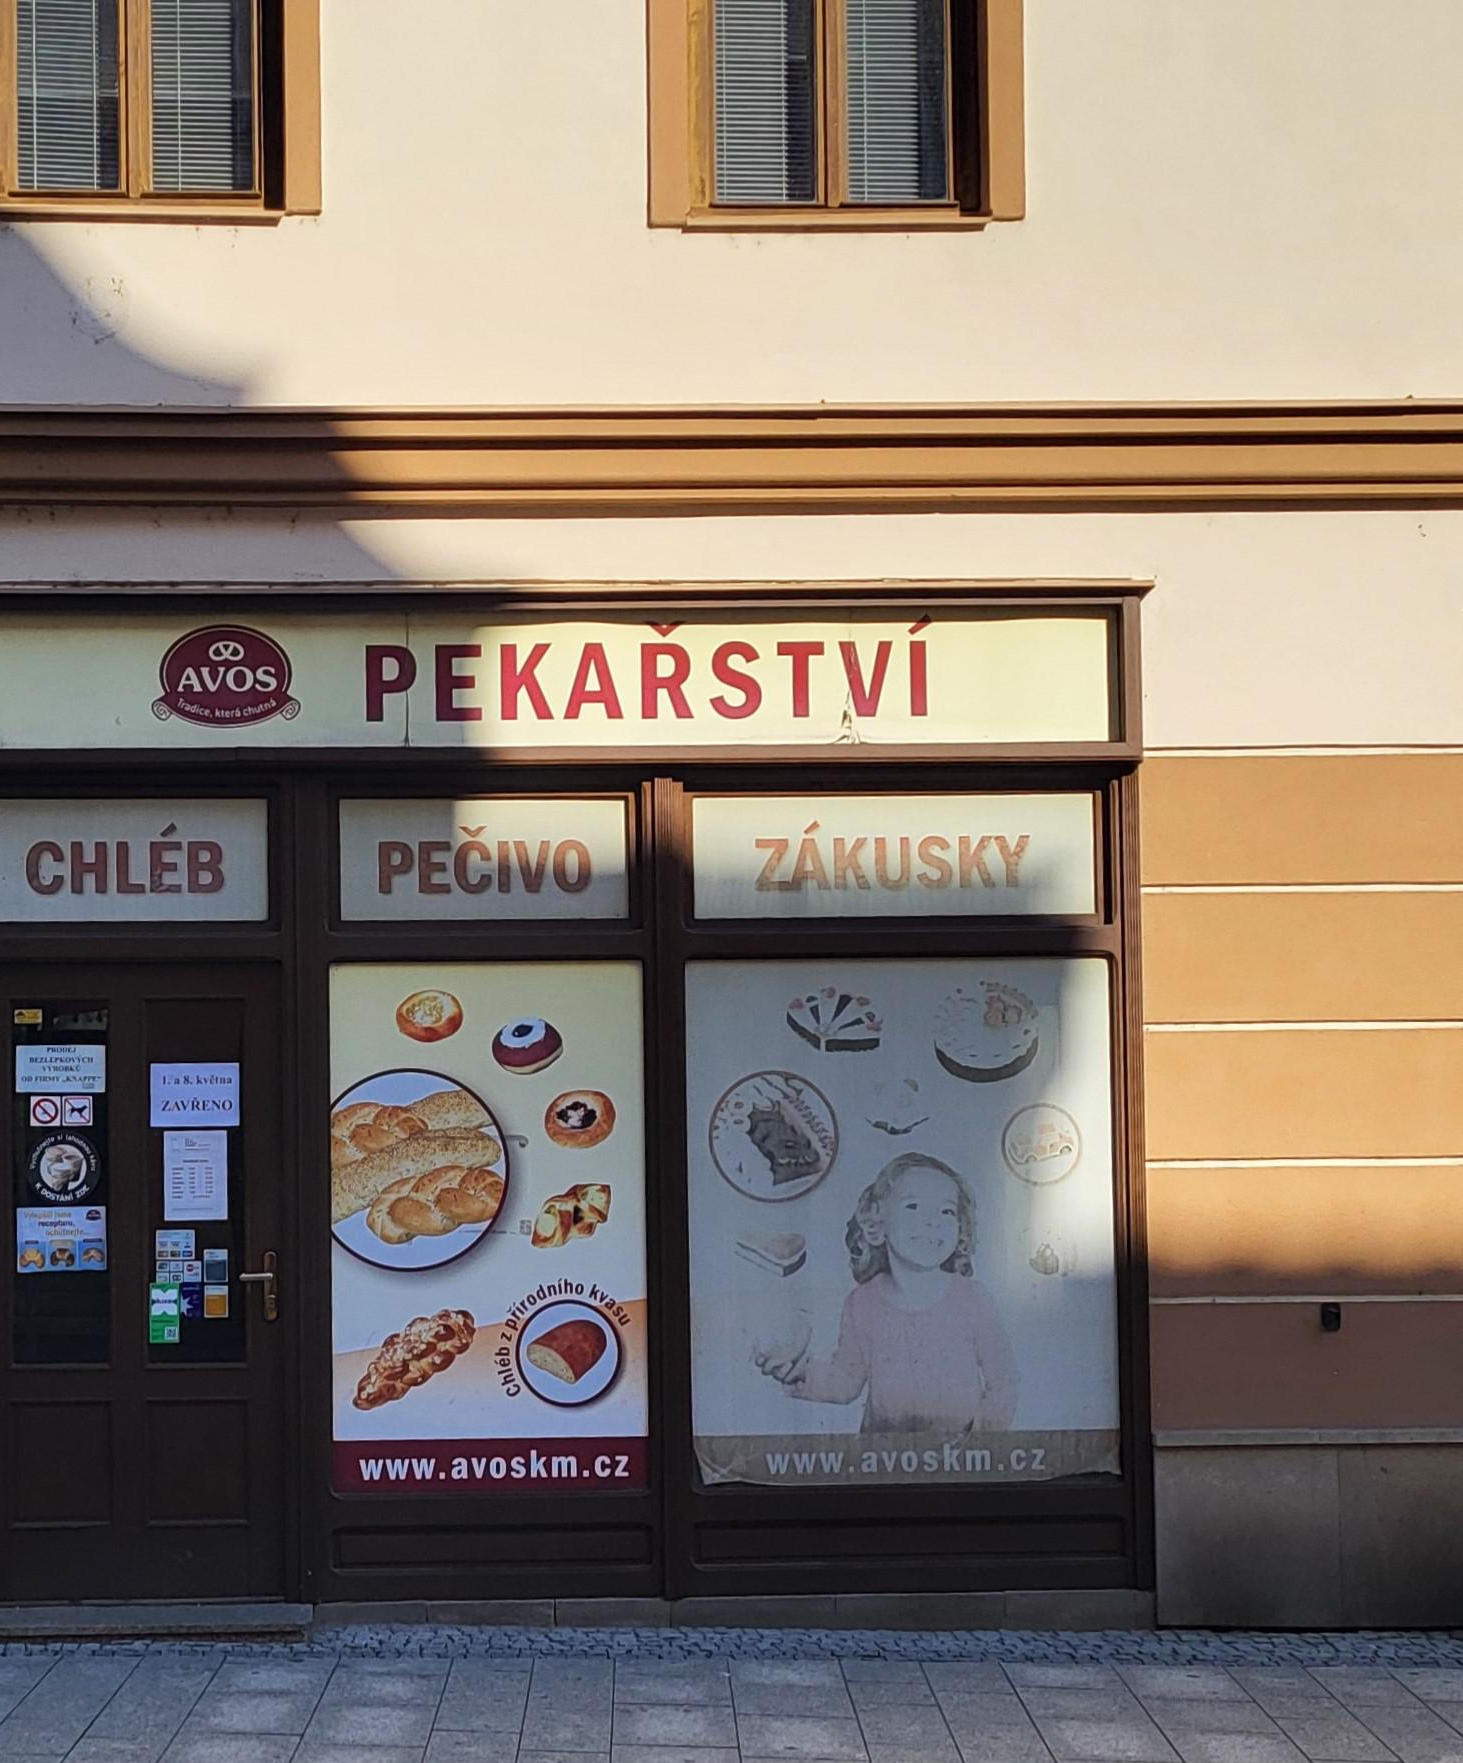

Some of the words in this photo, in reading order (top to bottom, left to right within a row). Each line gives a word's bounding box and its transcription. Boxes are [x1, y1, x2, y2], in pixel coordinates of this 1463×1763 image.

[177, 666, 278, 692] AVOS
[365, 614, 932, 722] PEKAŘSTVÍ
[177, 697, 214, 718] Tradice,
[214, 707, 241, 719] která
[242, 697, 277, 717] chutná
[25, 822, 225, 896] CHLÉB
[378, 825, 592, 895] PEČIVO
[754, 820, 1031, 892] ZÁKUSKY
[196, 1074, 233, 1085] května
[161, 1096, 233, 1111] ZAVŘENO
[504, 1278, 585, 1332] přírodního
[588, 1283, 632, 1327] kvasu
[500, 1331, 513, 1343] z
[494, 1346, 522, 1398] Chléb
[359, 1449, 630, 1481] www.avoskm.cz
[765, 1443, 1046, 1475] www.avoskm.cz
